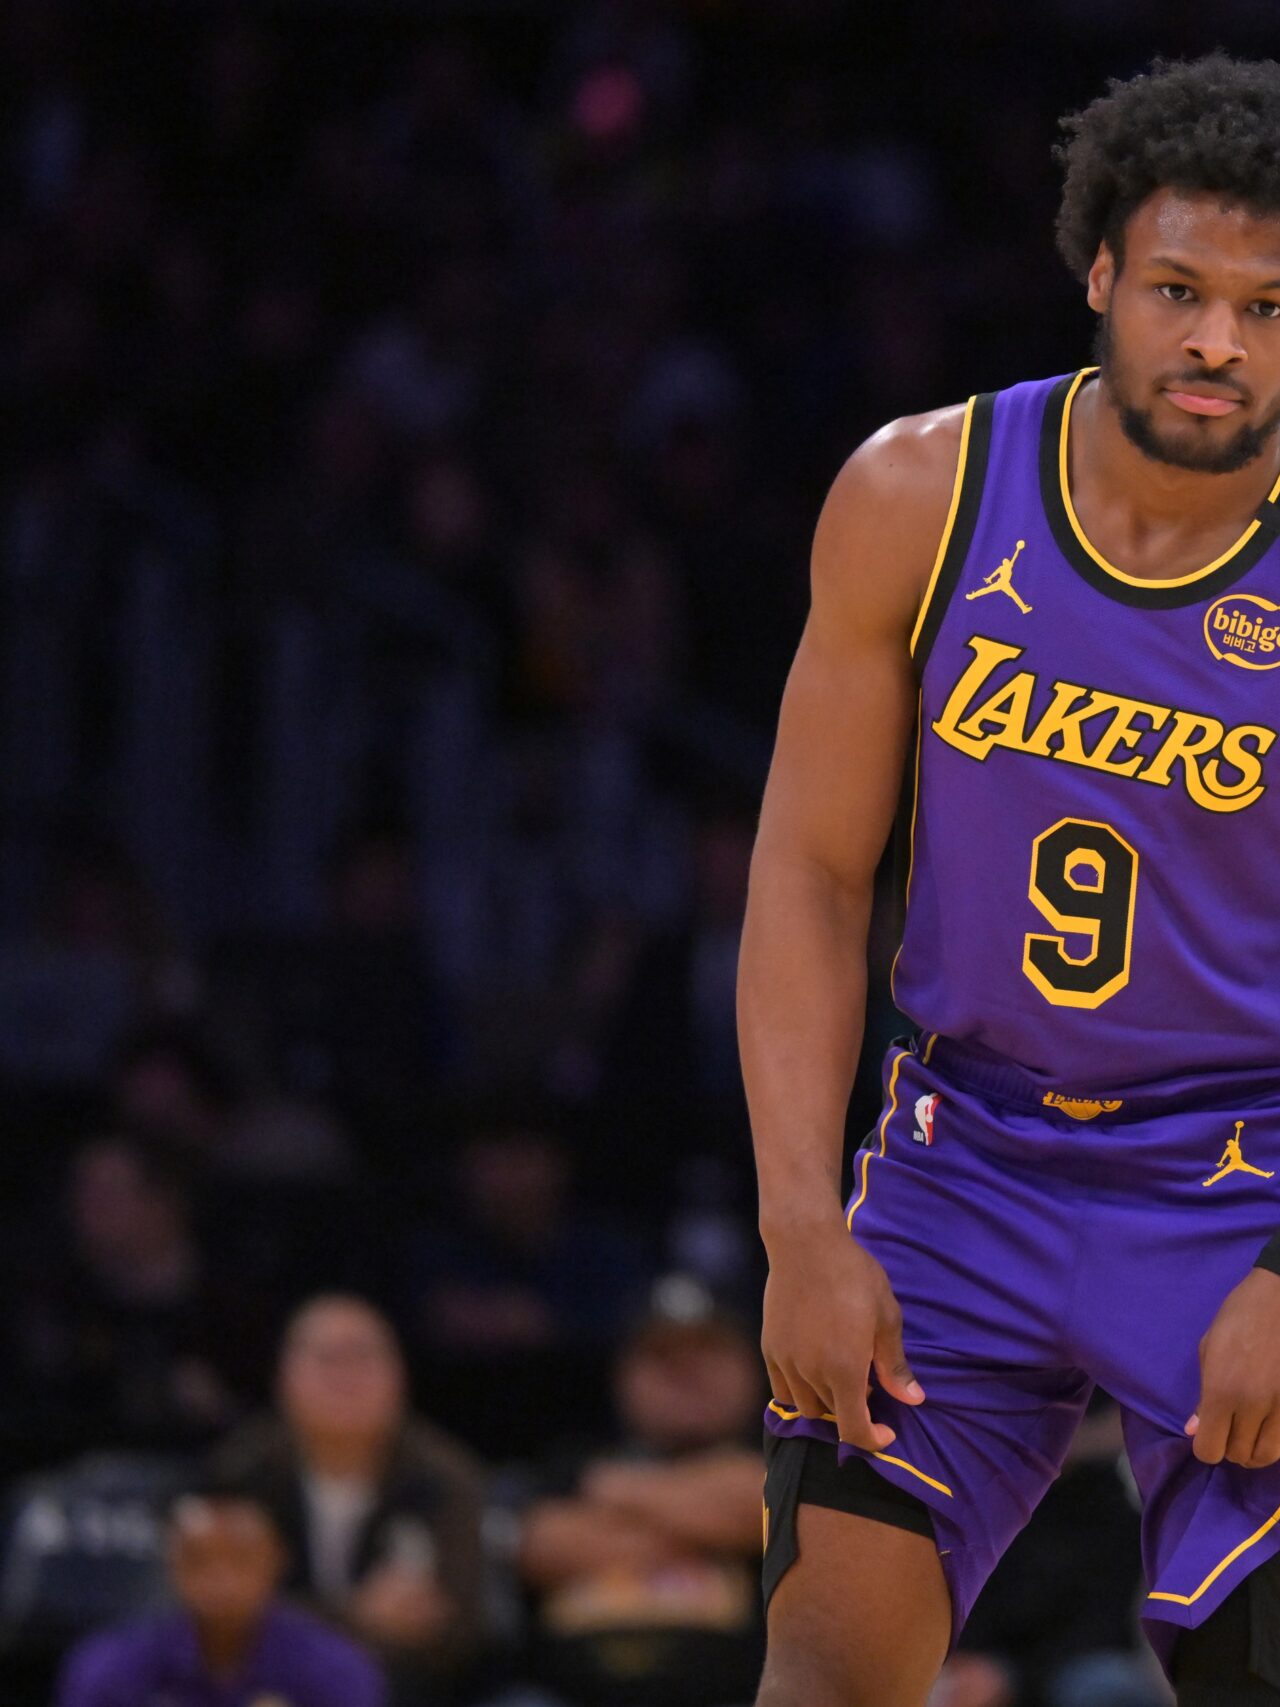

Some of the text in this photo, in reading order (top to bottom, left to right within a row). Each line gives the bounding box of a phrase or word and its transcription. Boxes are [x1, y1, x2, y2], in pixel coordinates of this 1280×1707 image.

[931, 634, 1279, 813] LAKERS
[1222, 633, 1257, 653] 비비고
[1022, 817, 1139, 1009] 9
